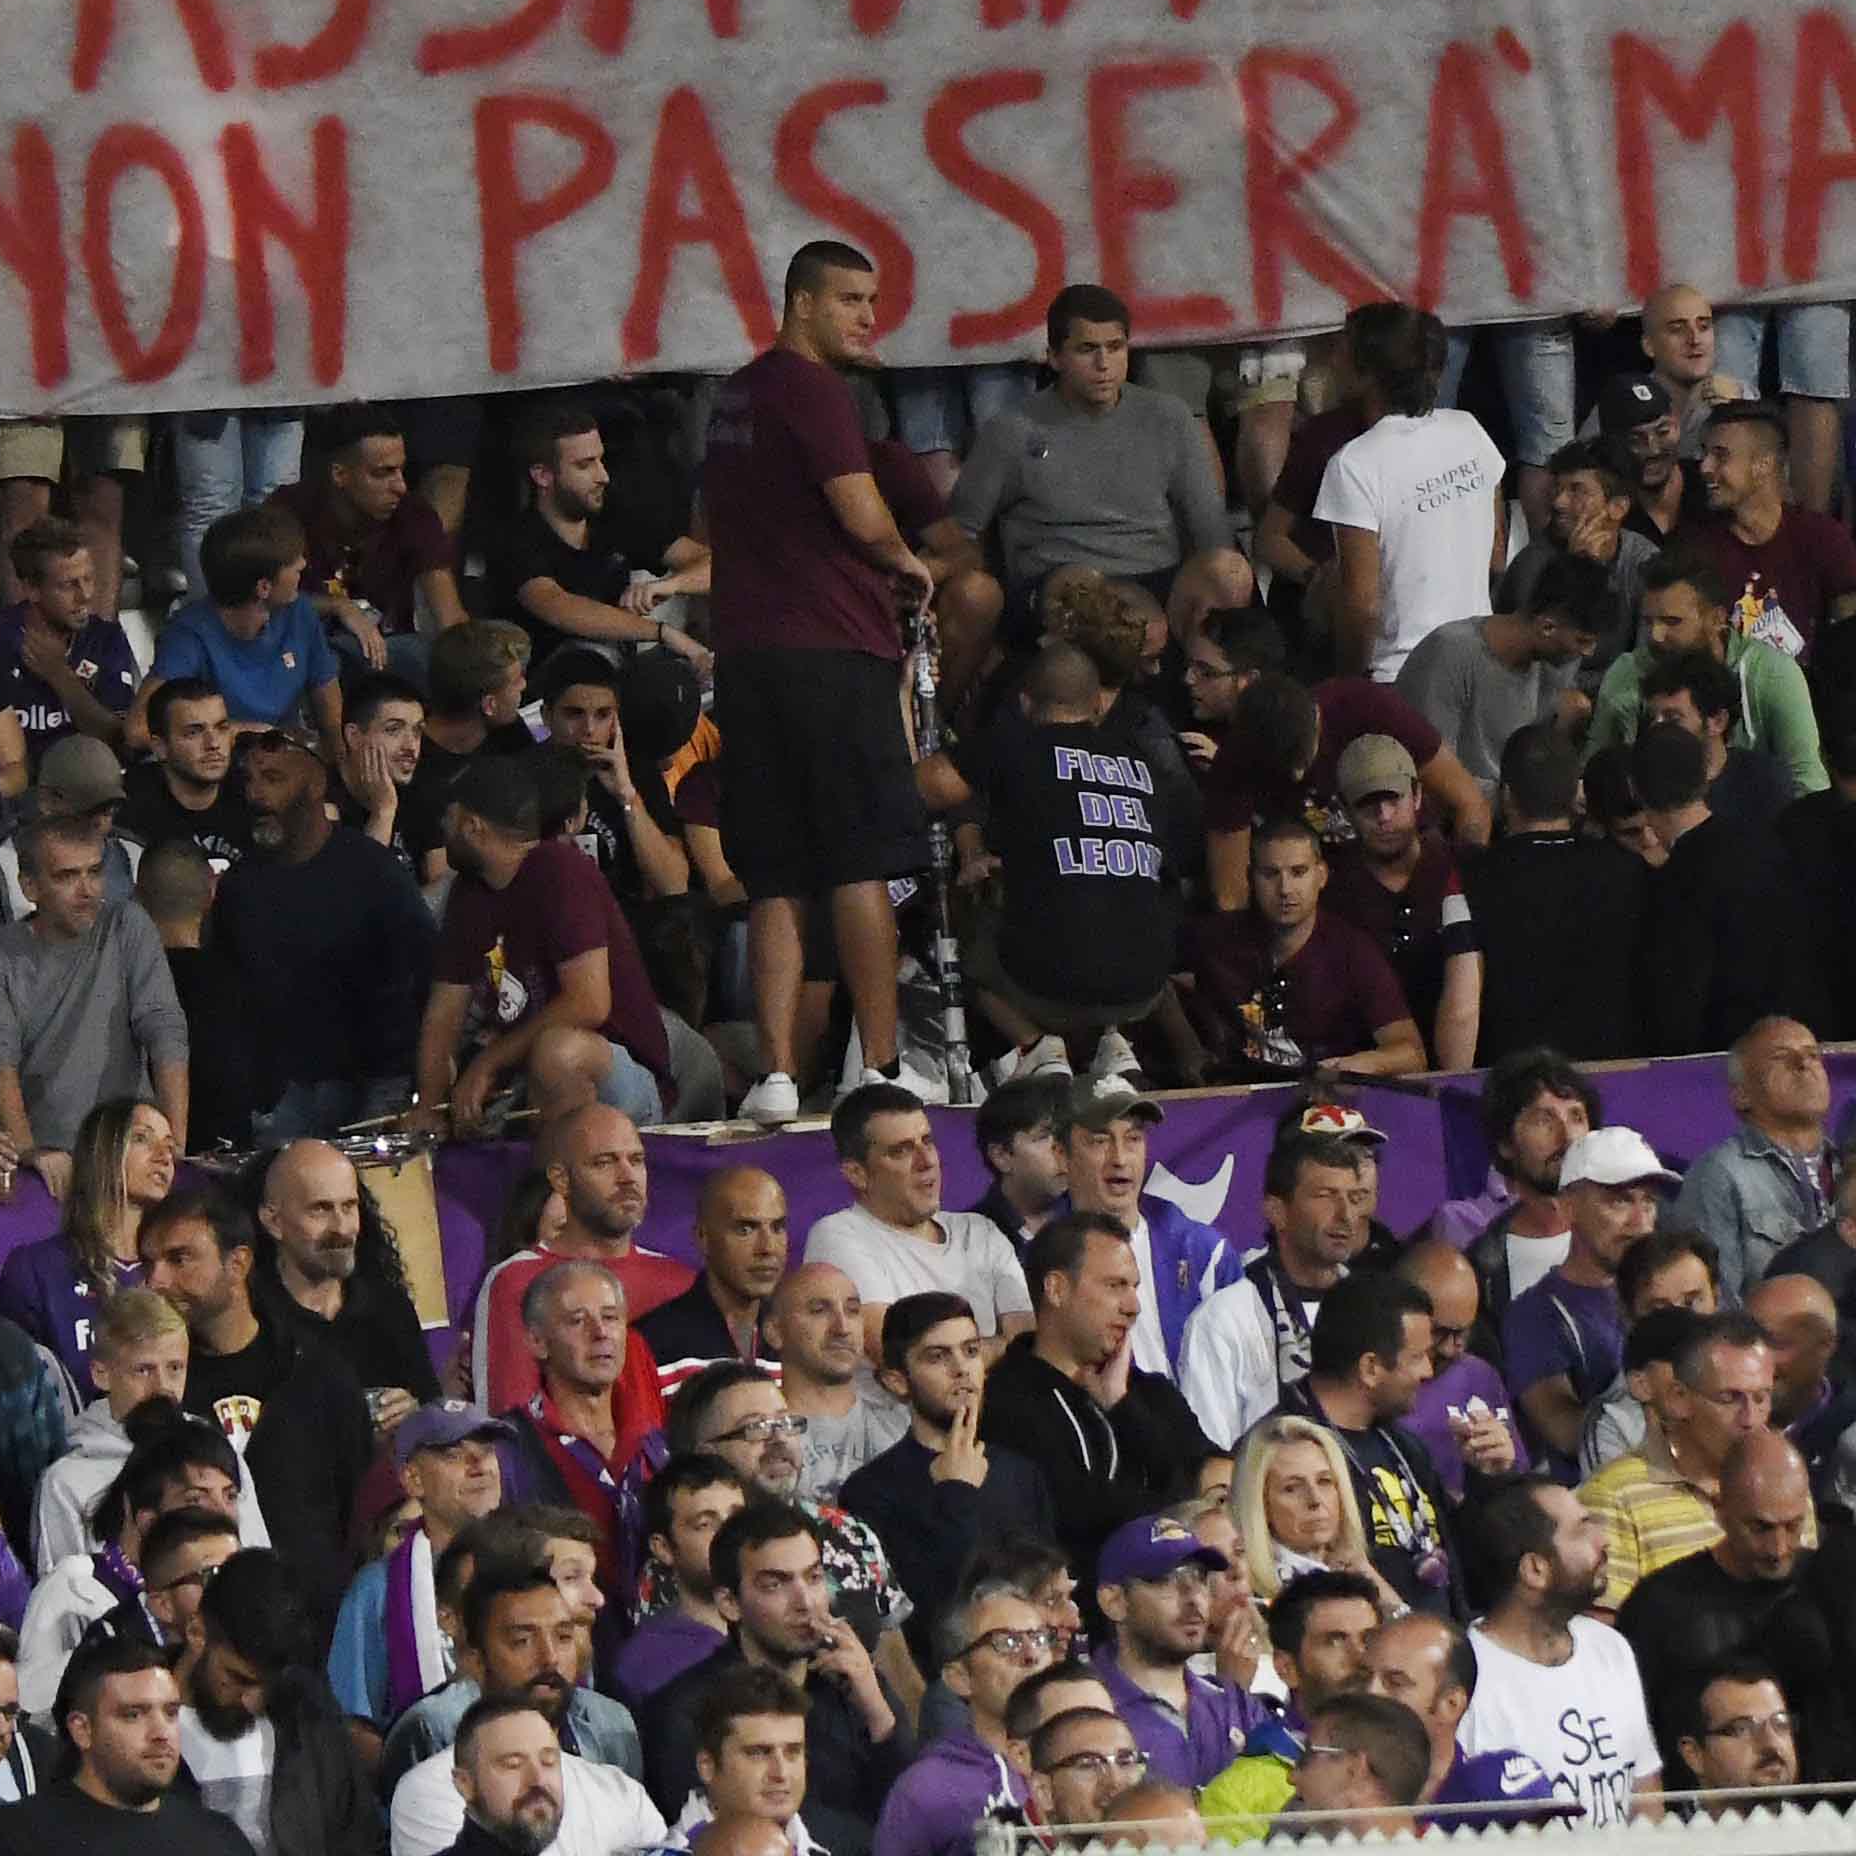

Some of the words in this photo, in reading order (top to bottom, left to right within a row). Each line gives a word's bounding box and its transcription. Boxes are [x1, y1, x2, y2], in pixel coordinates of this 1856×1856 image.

[1415, 457, 1480, 496] SEMPRE
[1053, 744, 1155, 795] FIGLI
[1079, 790, 1153, 834] DEL
[1558, 1707, 1617, 1766] SE
